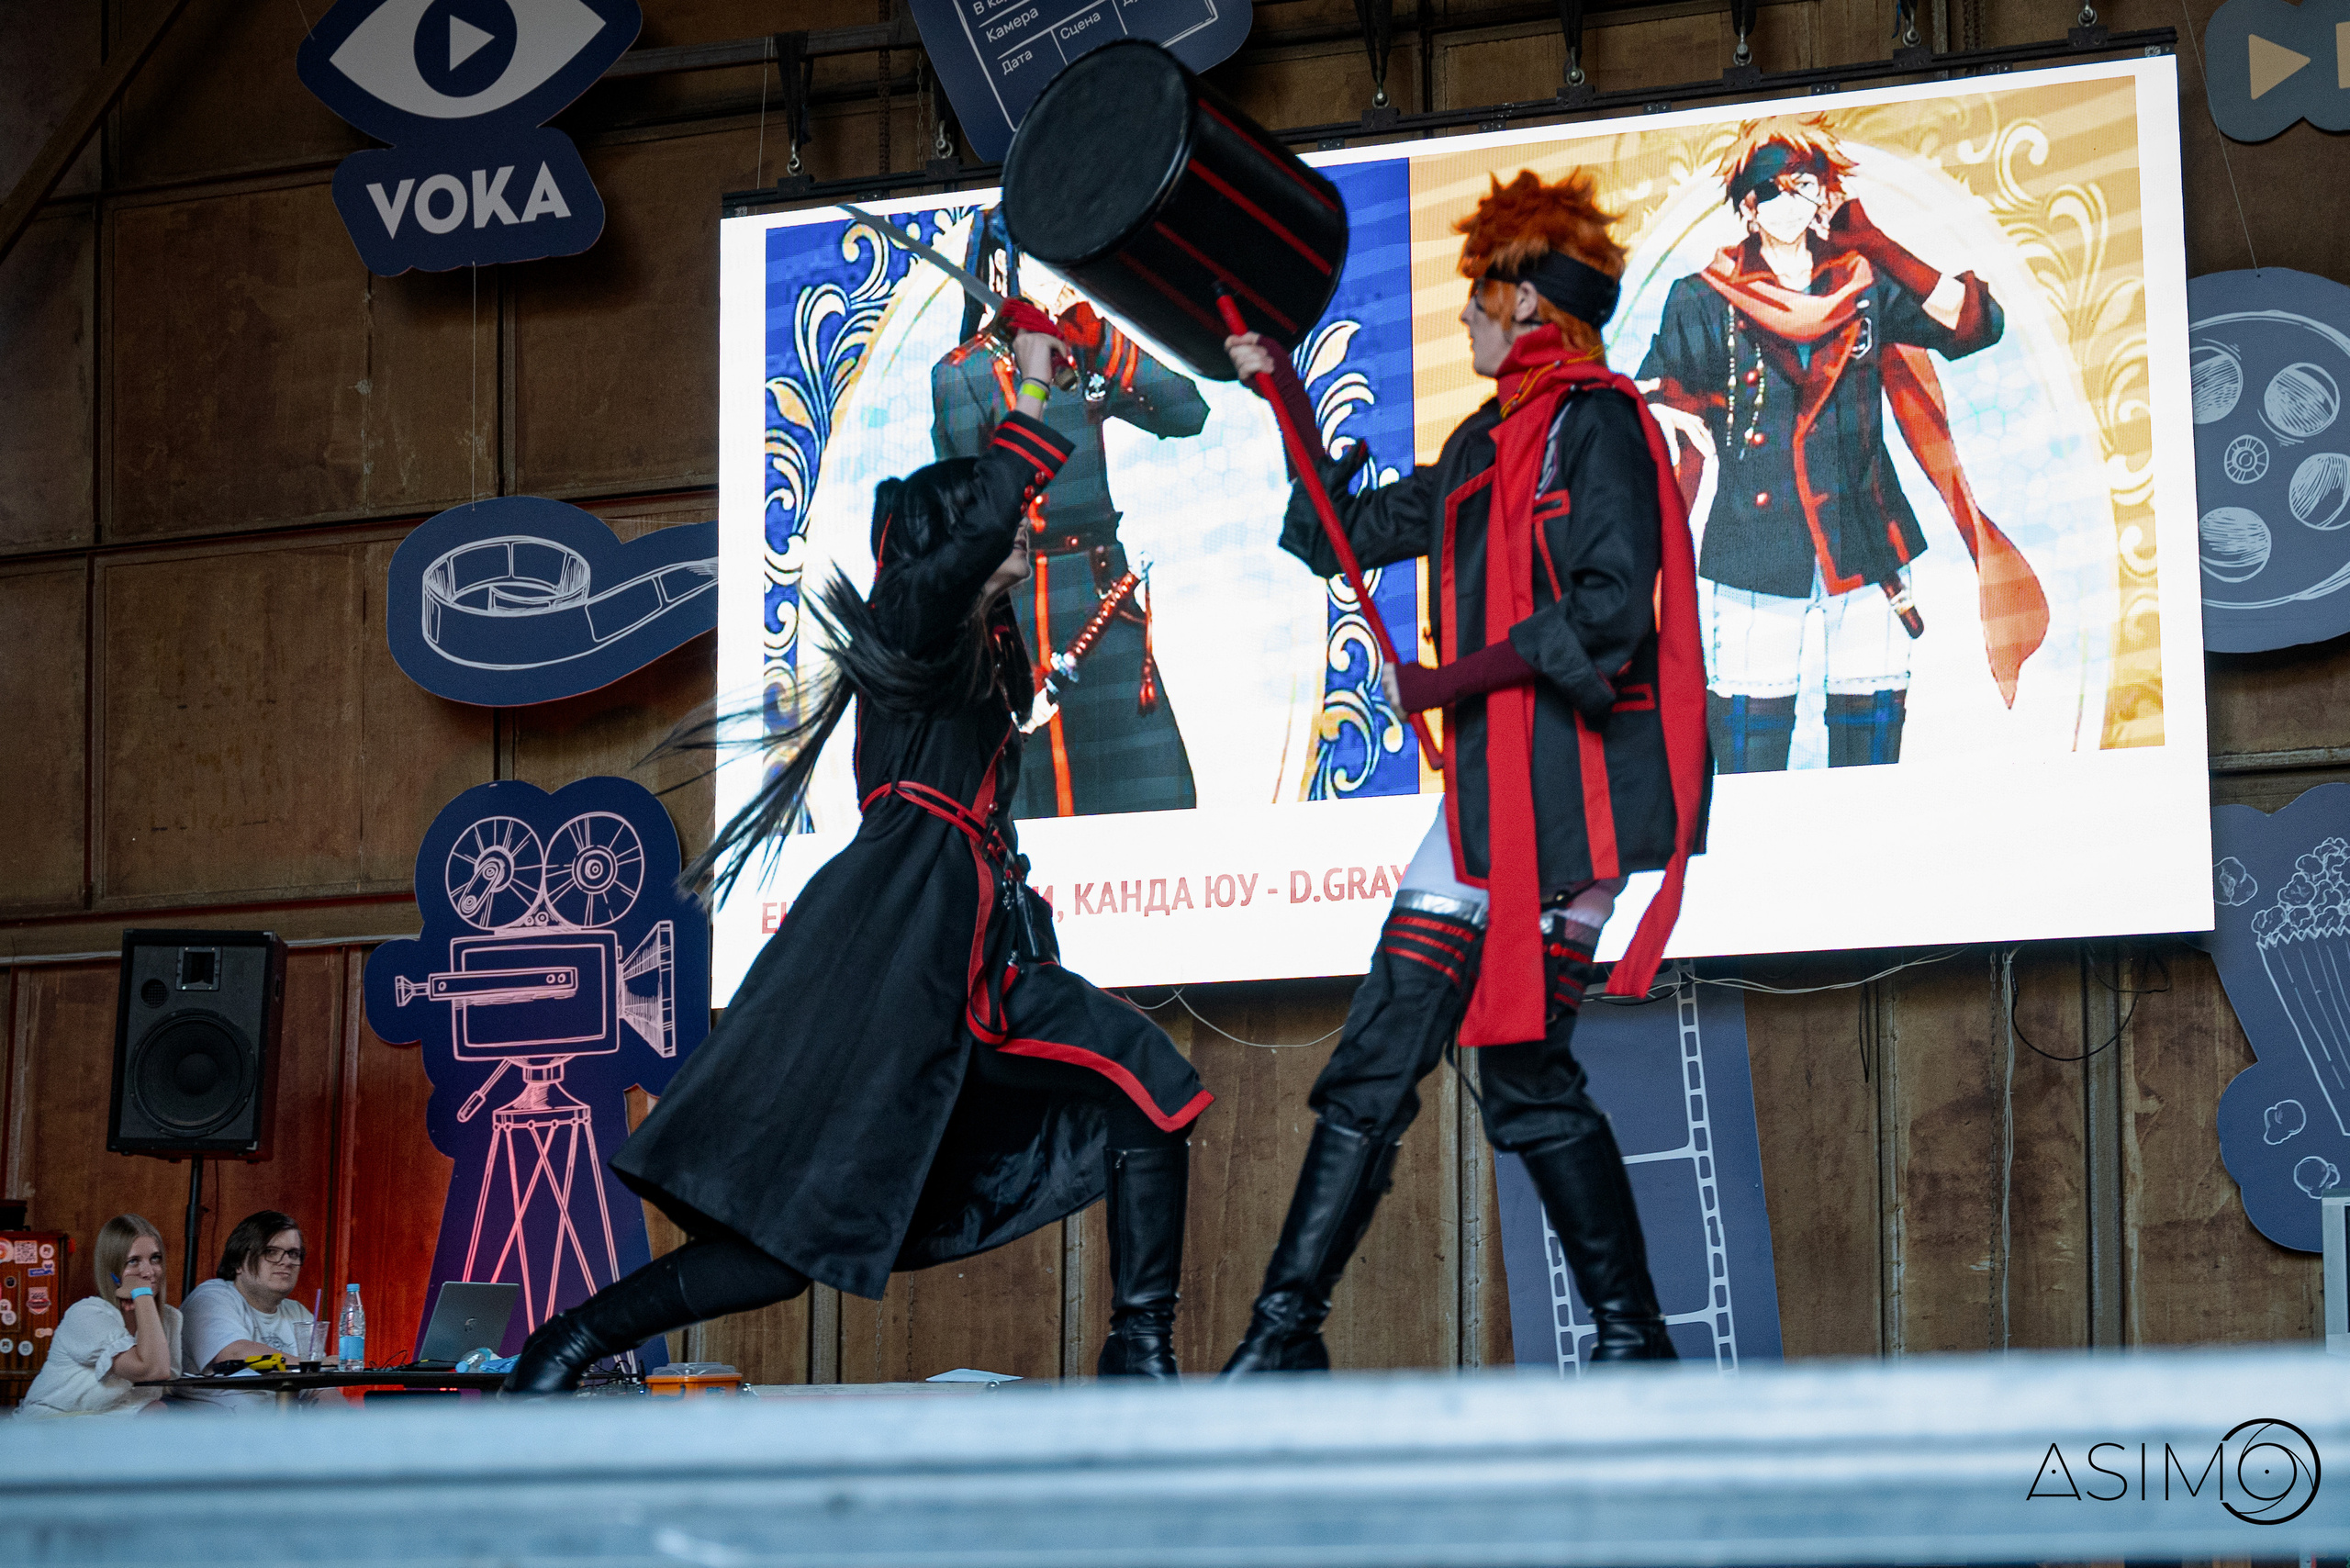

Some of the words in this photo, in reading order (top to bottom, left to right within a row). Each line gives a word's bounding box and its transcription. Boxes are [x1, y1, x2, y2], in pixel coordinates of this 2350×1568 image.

[973, 1, 985, 16] В
[985, 7, 1039, 43] Камера
[1059, 12, 1102, 40] Сцена
[1001, 50, 1034, 75] Дата
[365, 160, 572, 241] VOKA
[1074, 877, 1194, 917] КАНДА
[1204, 872, 1259, 908] ЮУ
